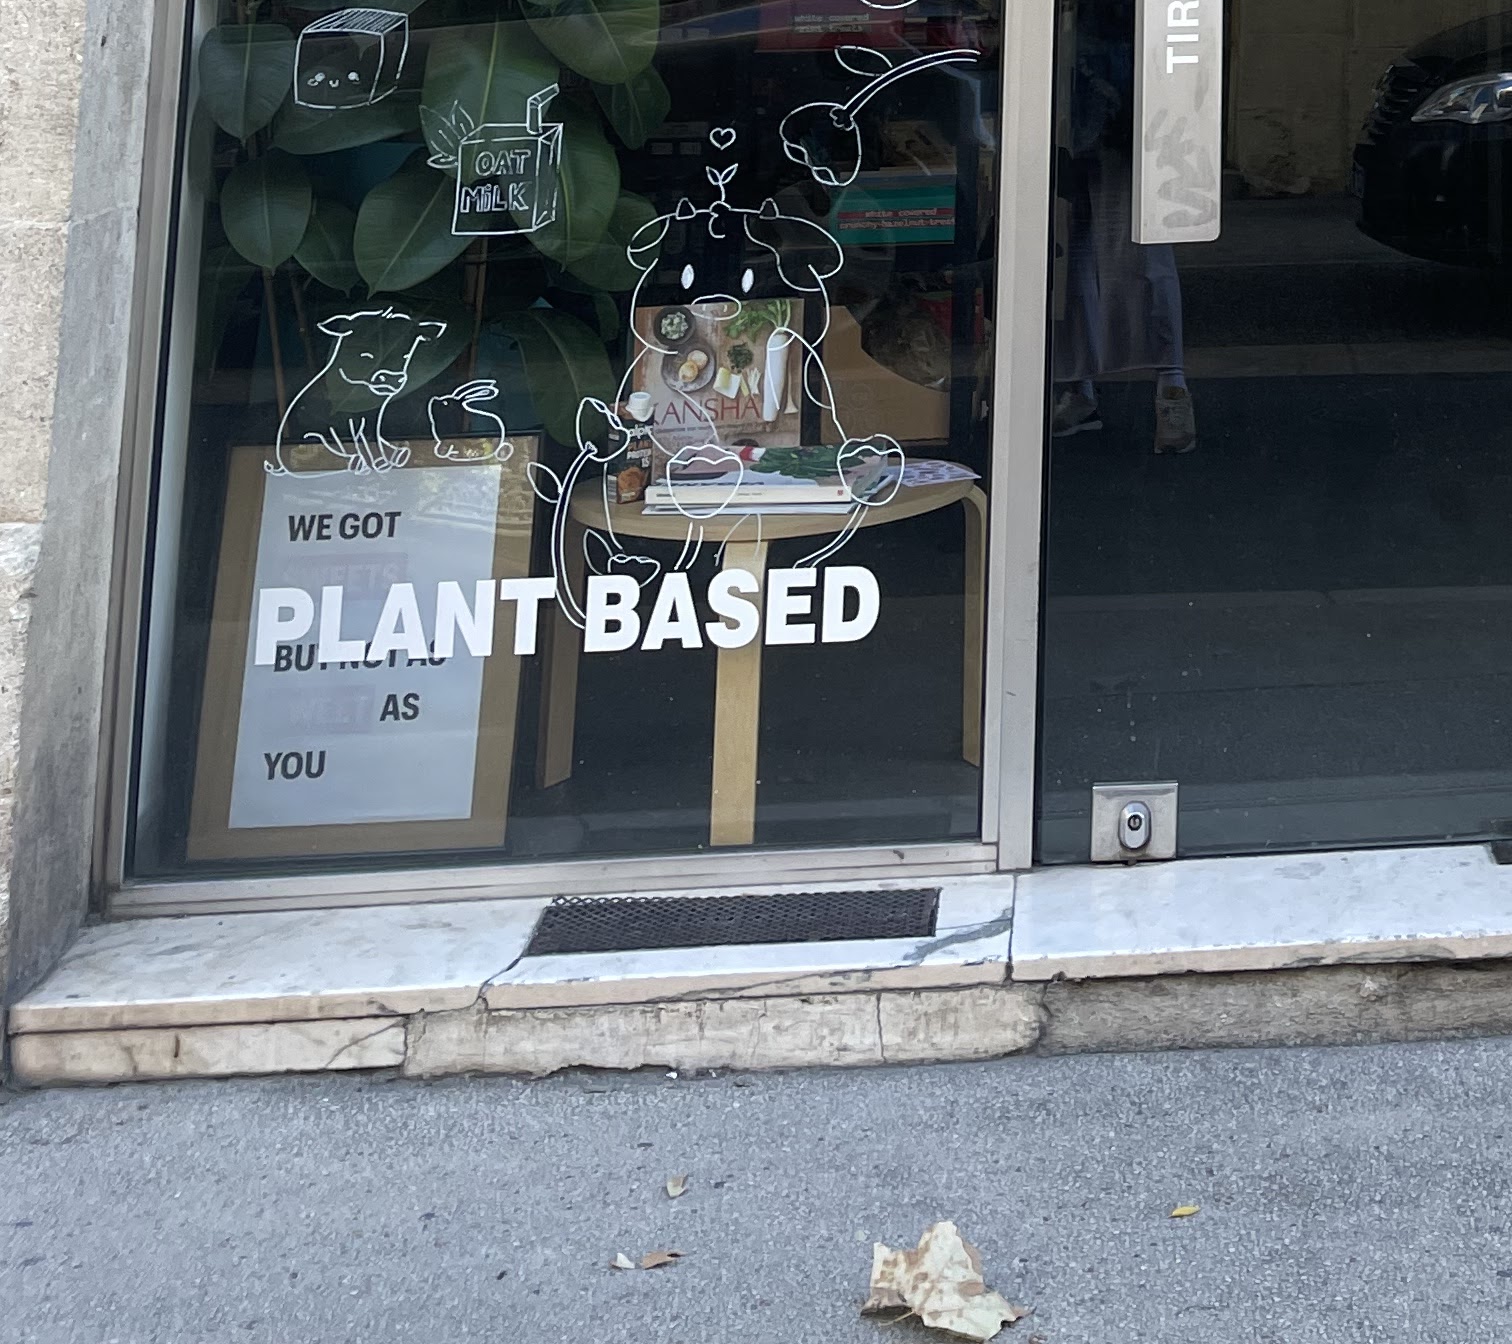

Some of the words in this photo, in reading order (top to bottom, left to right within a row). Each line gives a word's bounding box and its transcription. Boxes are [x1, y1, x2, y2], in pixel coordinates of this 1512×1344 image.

[475, 148, 532, 177] OAT
[288, 514, 333, 542] WE
[339, 511, 402, 540] GOT
[254, 576, 558, 666] PLANT
[584, 564, 881, 653] BASED
[379, 693, 420, 721] AS
[264, 750, 327, 780] YOU
